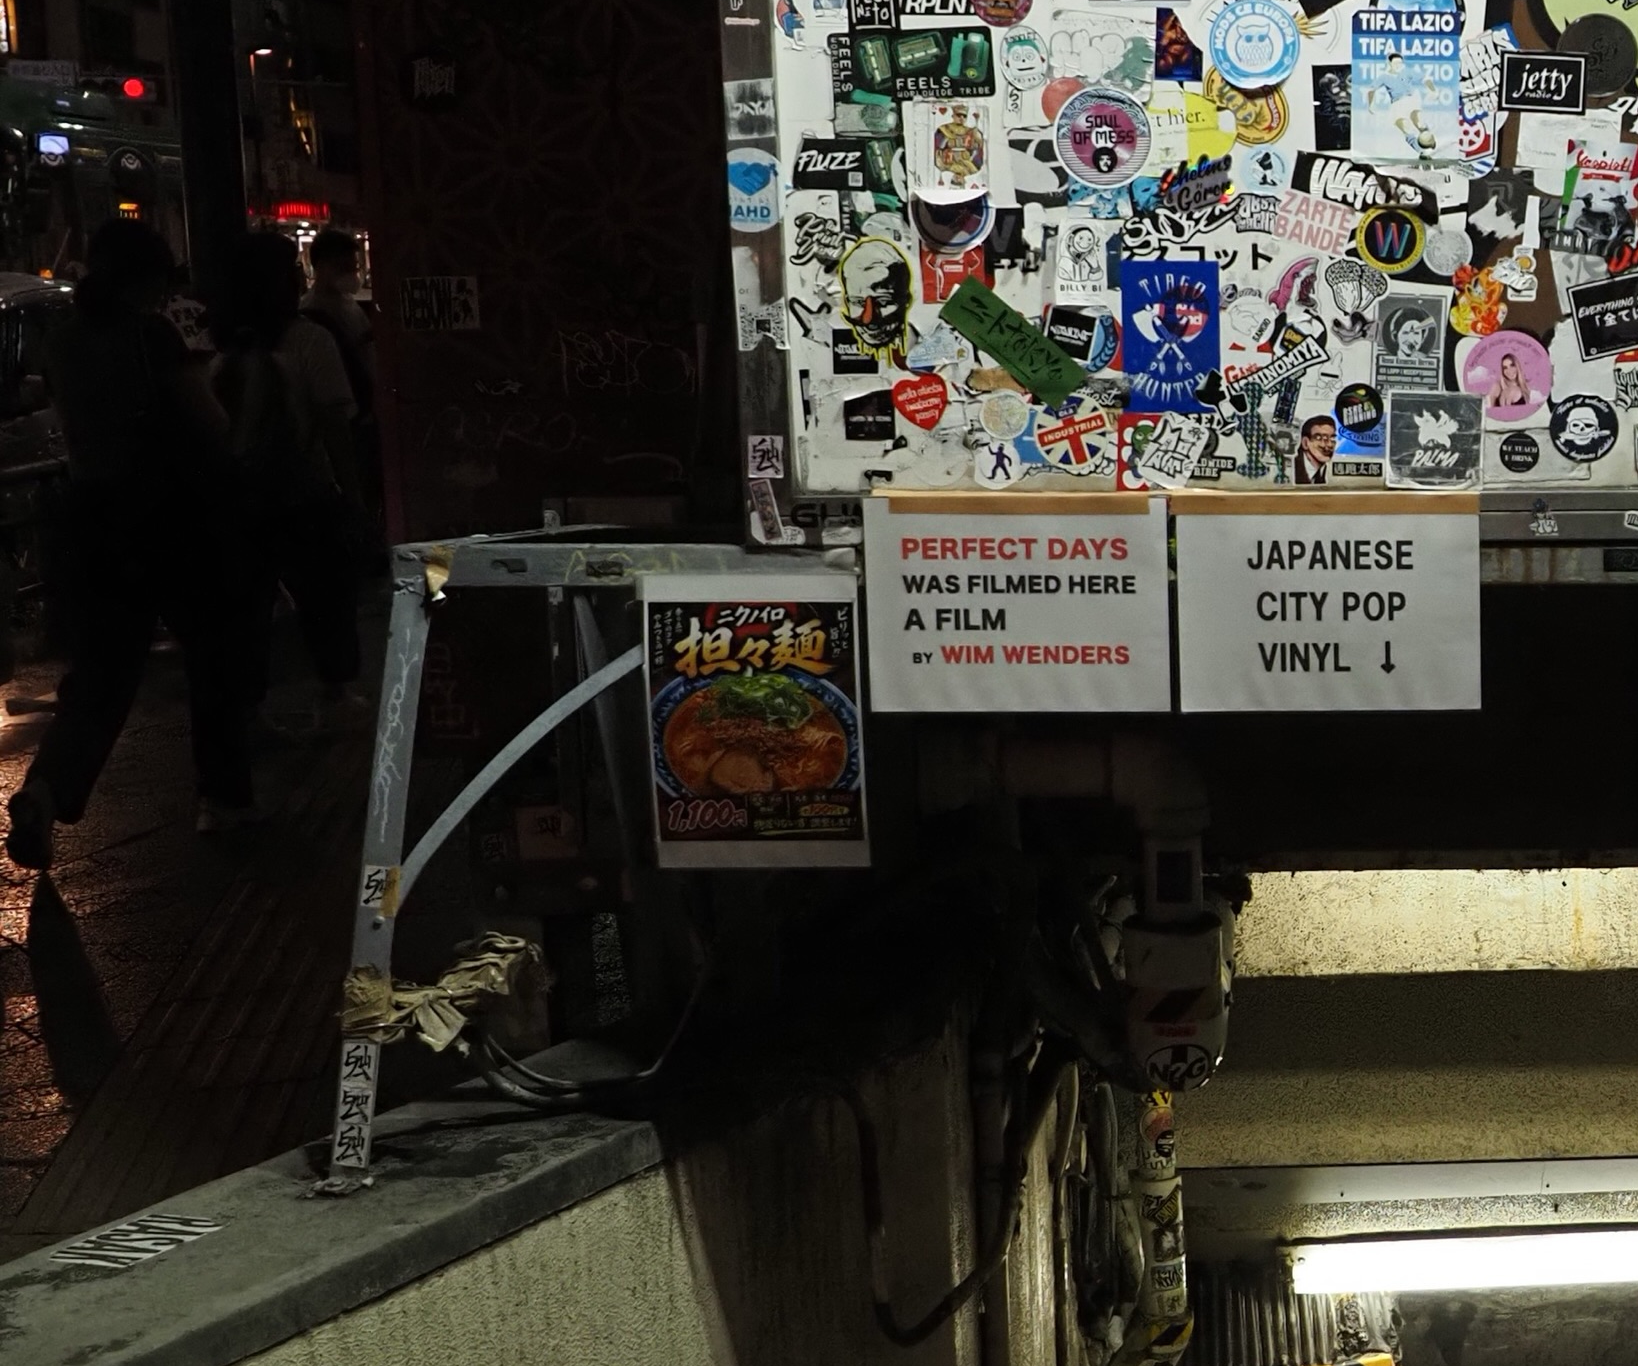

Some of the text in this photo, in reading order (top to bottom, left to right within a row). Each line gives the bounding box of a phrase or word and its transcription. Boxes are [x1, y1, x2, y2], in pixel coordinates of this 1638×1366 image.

[1358, 11, 1456, 33] TIFA LAZIO
[1359, 36, 1454, 57] TIFA LAZIO
[840, 35, 853, 93] FEELS
[896, 76, 952, 91] FEELS
[1512, 62, 1574, 100] jetty
[1084, 113, 1120, 130] SOUL
[1167, 105, 1206, 126] hier.
[1073, 129, 1135, 145] OF MESS
[798, 148, 862, 173] FLUZE
[733, 204, 772, 220] AHD
[1279, 189, 1356, 230] ZARTE
[1275, 214, 1348, 256] BANDE
[1059, 283, 1088, 293] BILLY
[1138, 276, 1208, 299] TIAGO
[1578, 296, 1634, 319] EVERYTHING
[1042, 416, 1105, 444] INDUSTRIAL
[1410, 448, 1460, 469] PALMA
[901, 537, 1128, 561] PERFECT DAYS
[1246, 540, 1414, 570] JAPANESE
[902, 574, 1137, 595] WAS FILMED HERE
[717, 605, 786, 627] ニクノイロ
[1256, 591, 1407, 622] CITY POP
[903, 608, 1006, 632] A FILM
[673, 616, 840, 680] 担々麺
[912, 644, 1131, 665] BY WIM WENDERS
[1257, 642, 1352, 673] VINYL
